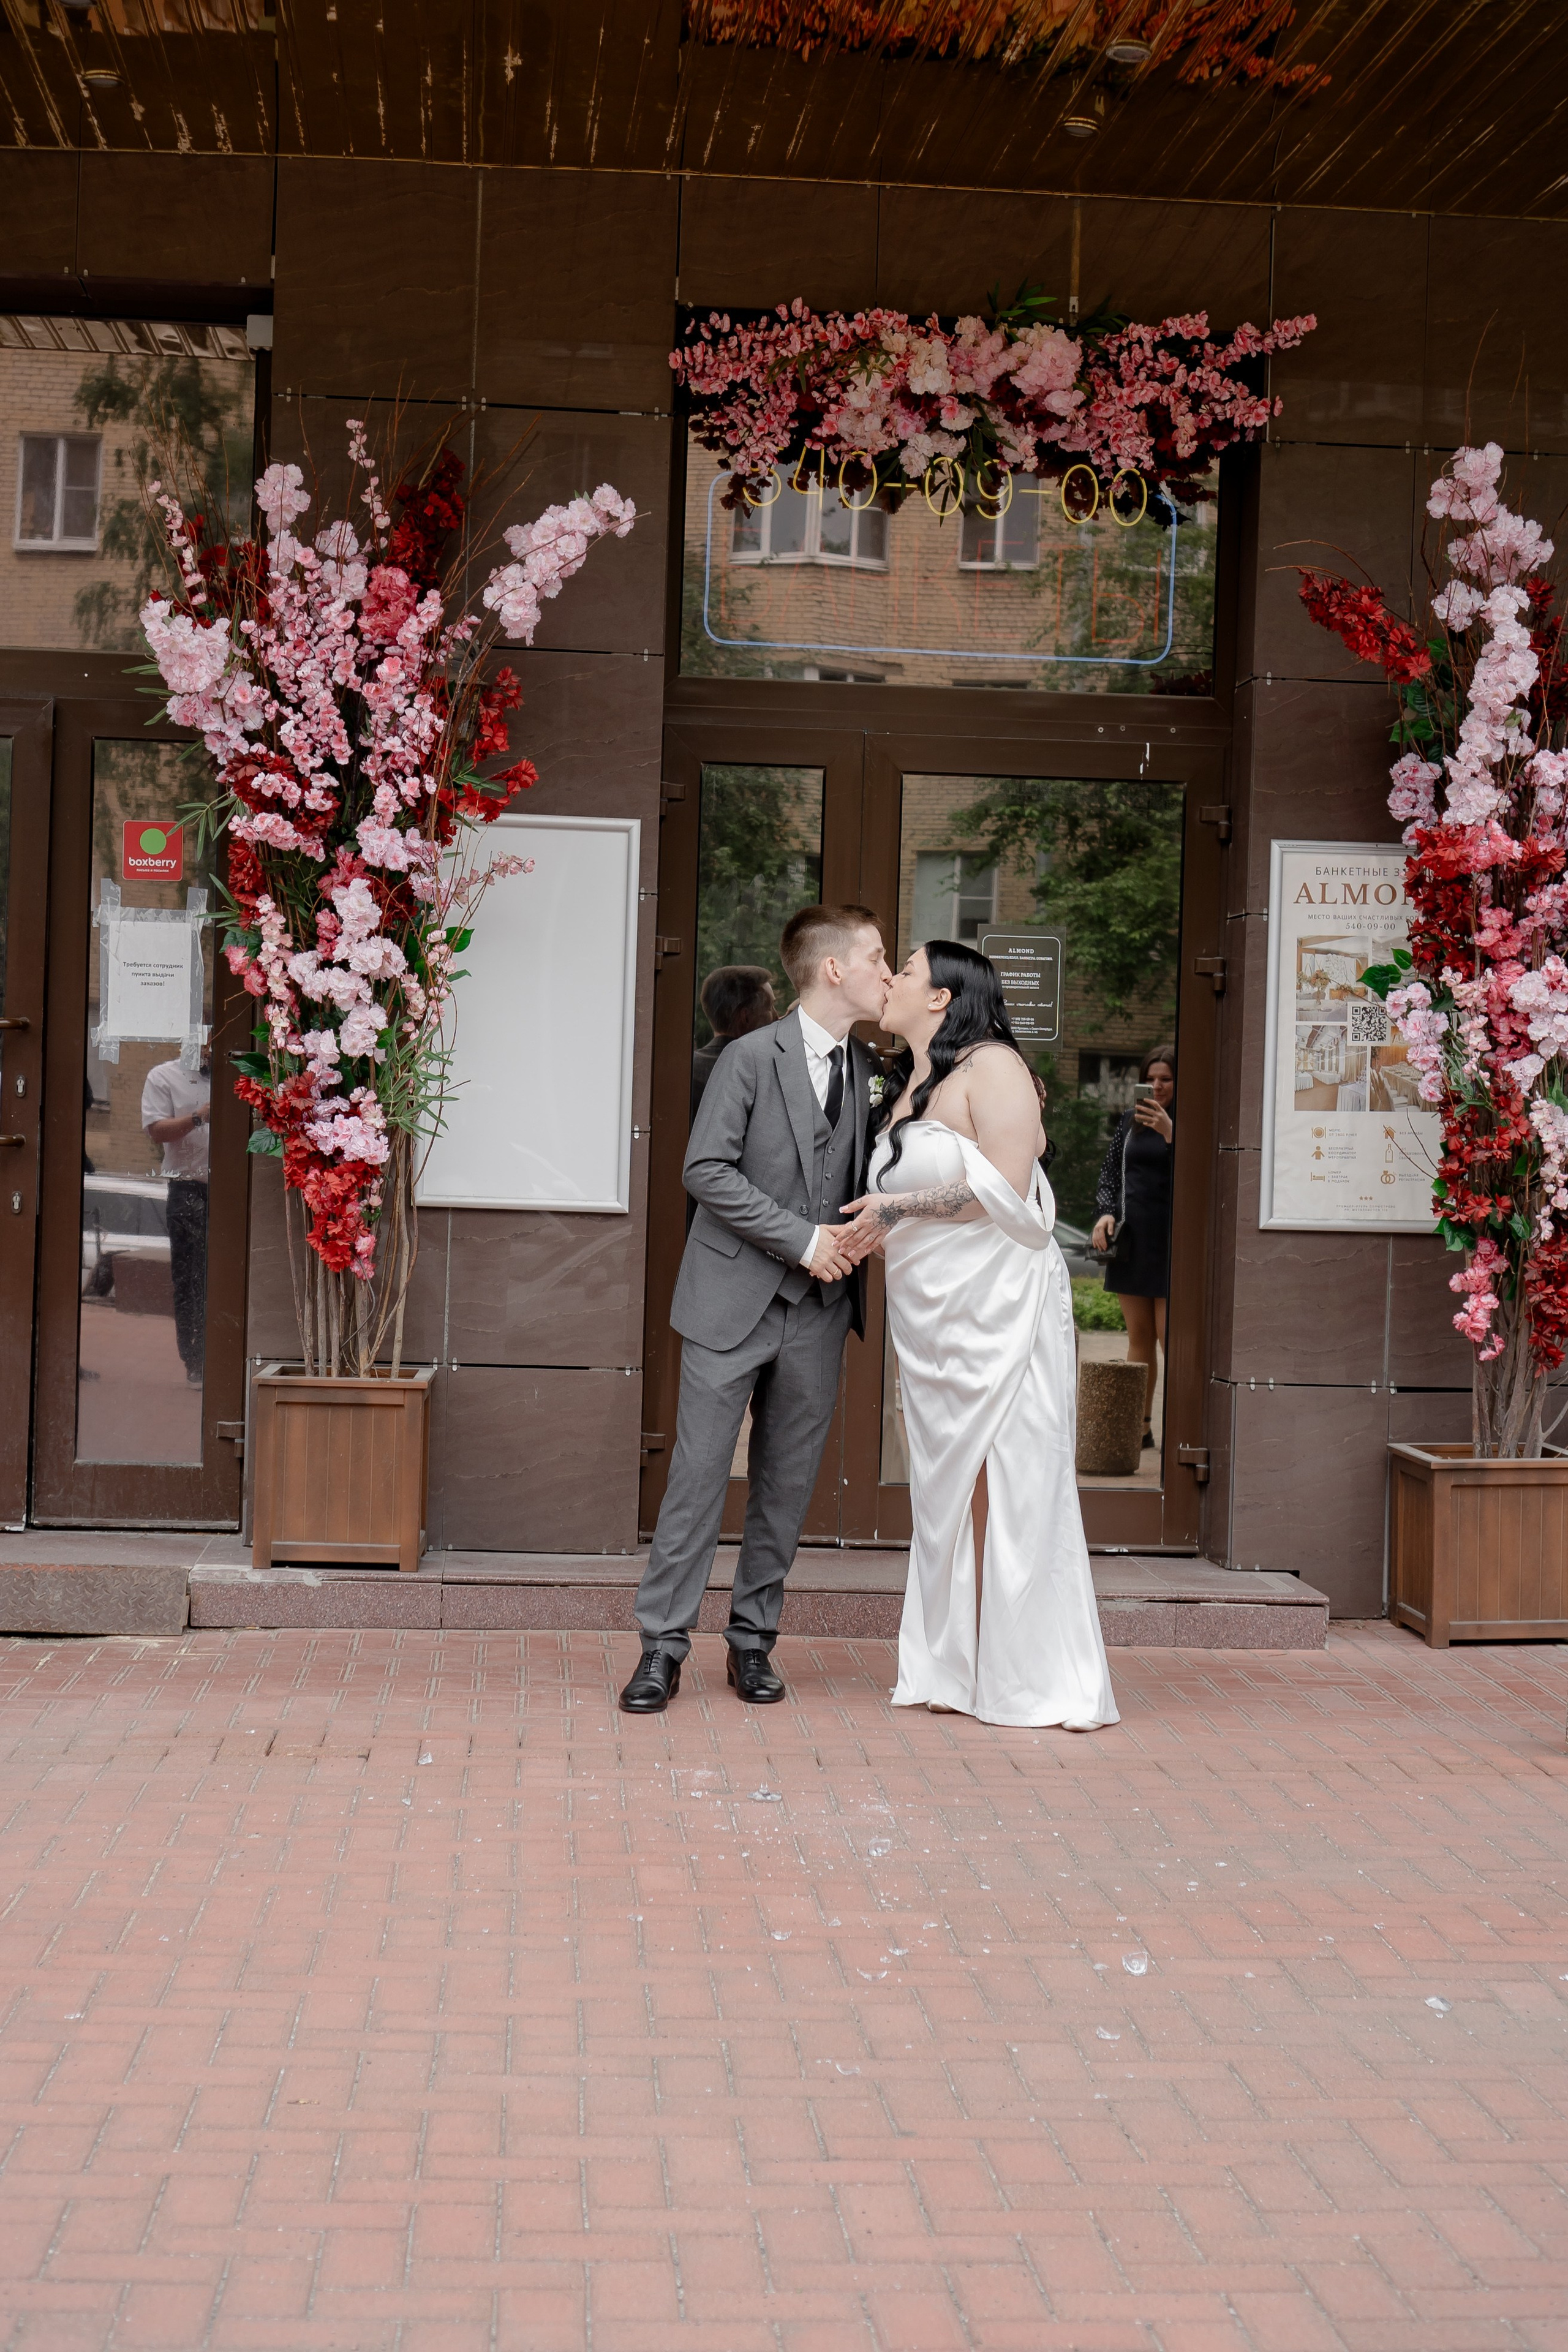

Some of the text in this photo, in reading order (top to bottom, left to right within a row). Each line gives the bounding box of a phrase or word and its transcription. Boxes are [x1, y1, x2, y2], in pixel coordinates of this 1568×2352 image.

[129, 856, 176, 869] boxberry
[1316, 866, 1389, 877] БАНКЕТНЫЕ
[1293, 882, 1410, 905] ALMO
